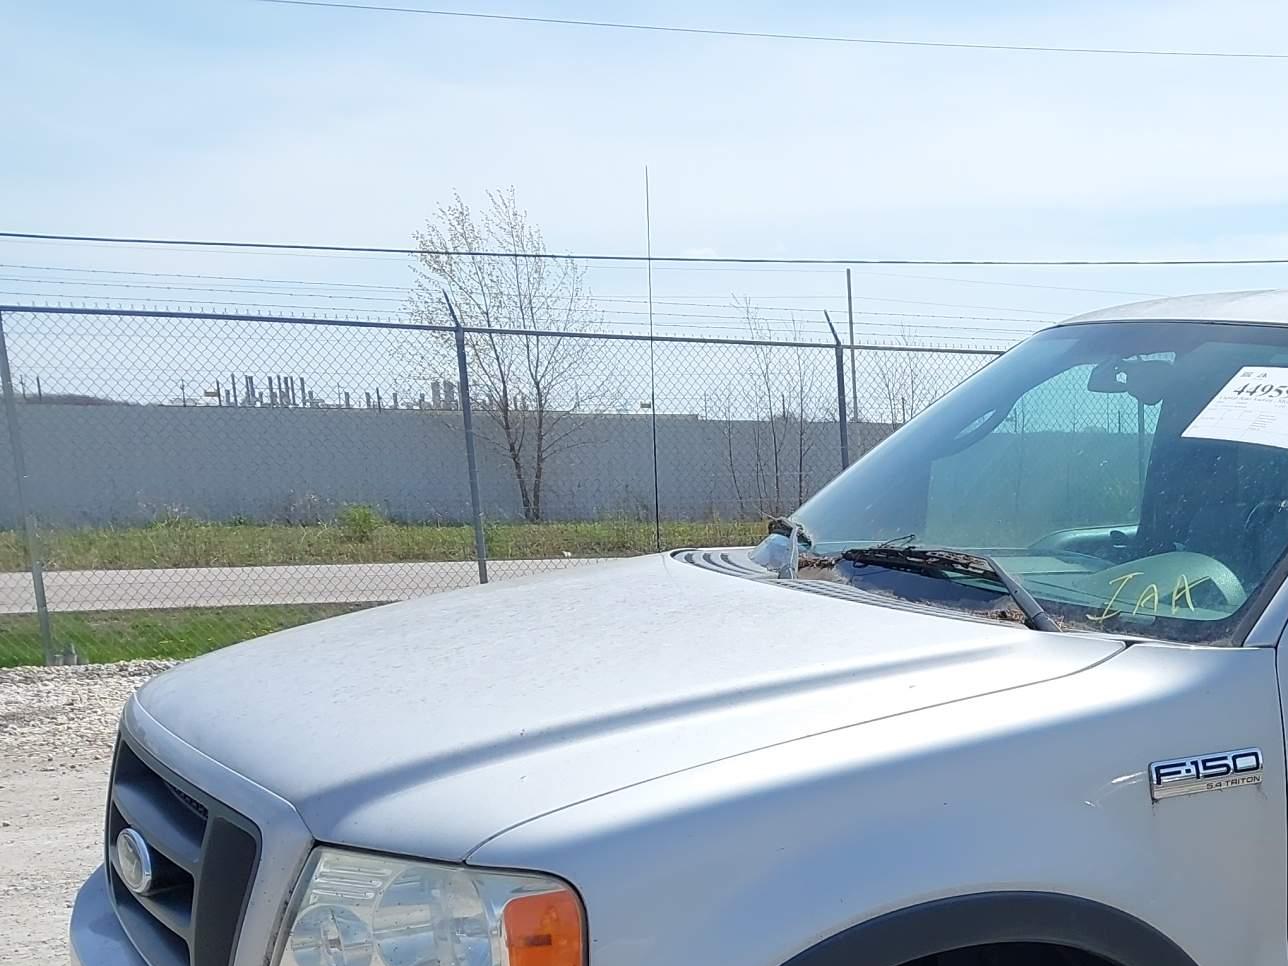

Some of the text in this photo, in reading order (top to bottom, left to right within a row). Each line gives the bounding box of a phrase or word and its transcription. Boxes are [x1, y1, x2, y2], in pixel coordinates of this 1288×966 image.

[1085, 572, 1211, 623] IAA
[1154, 751, 1261, 786] F-150
[1226, 775, 1261, 786] TRITON
